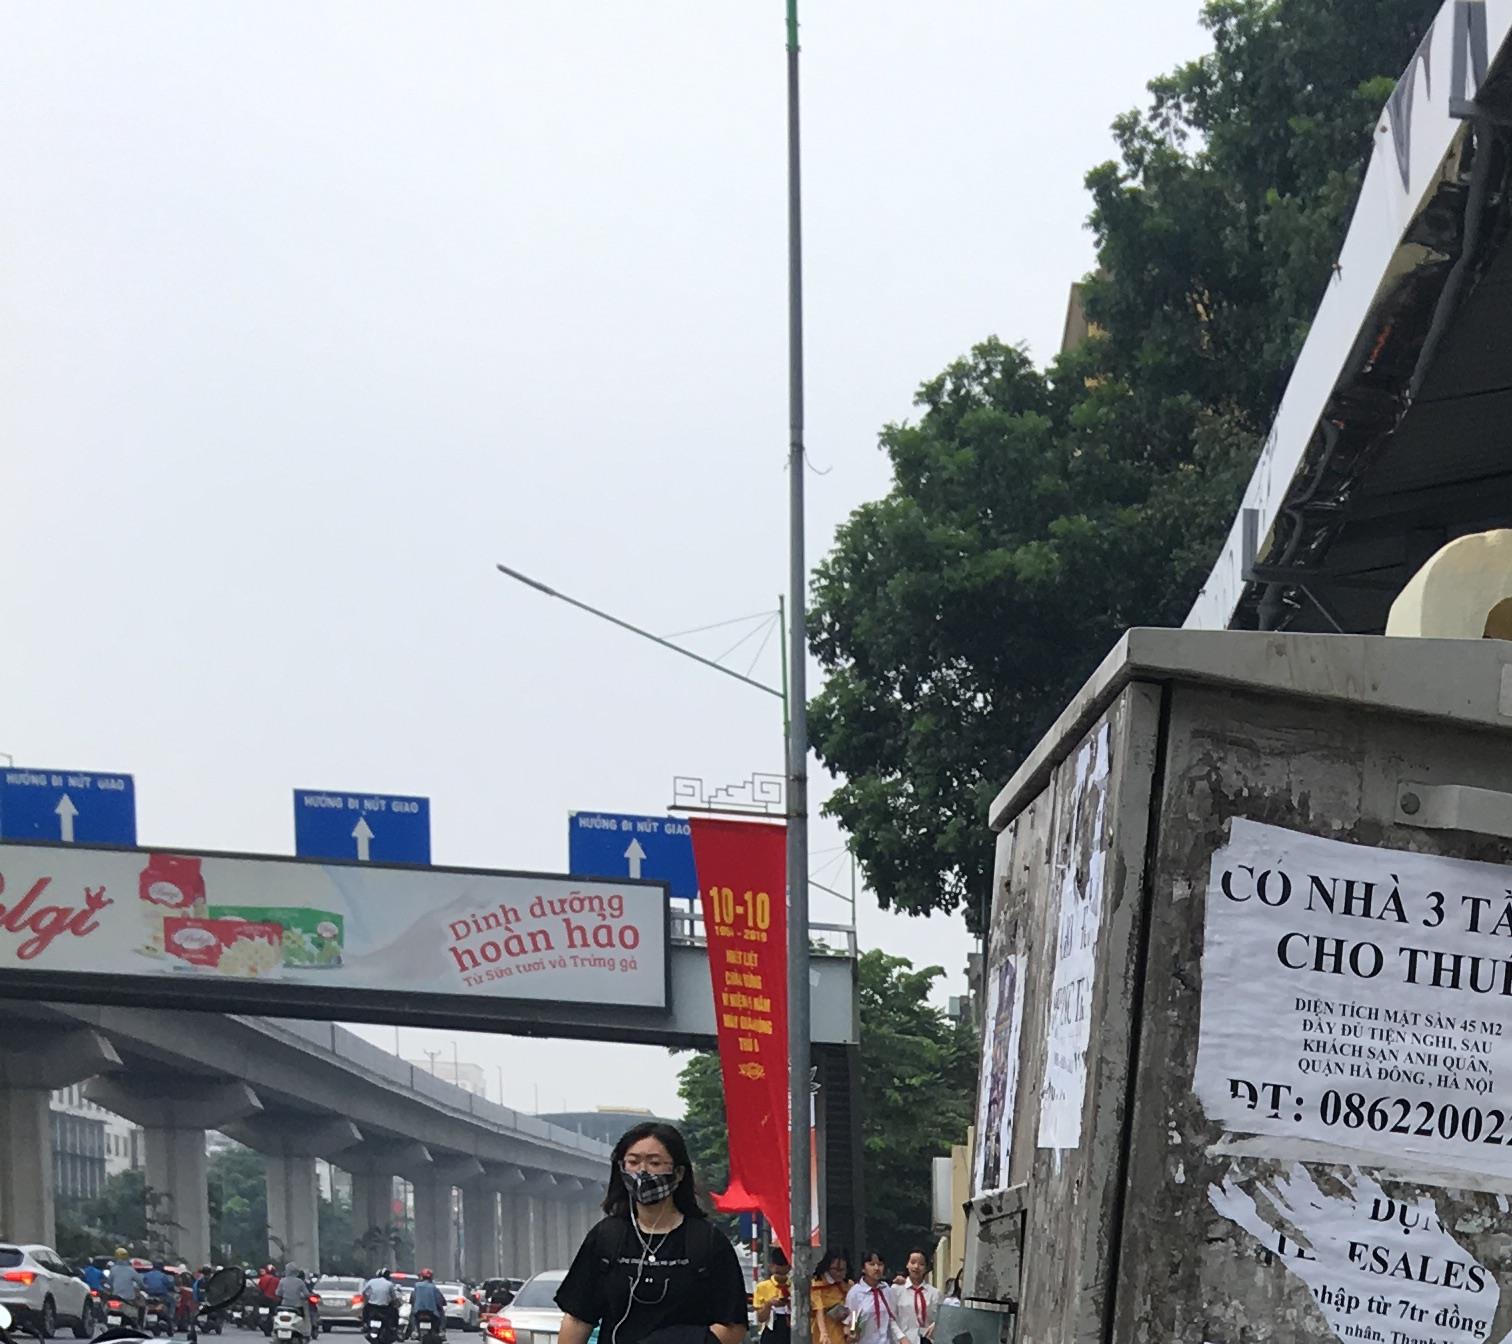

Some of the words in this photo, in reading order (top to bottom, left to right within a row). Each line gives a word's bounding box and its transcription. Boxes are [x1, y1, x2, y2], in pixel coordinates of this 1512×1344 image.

[664, 823, 692, 835] GIAO
[709, 886, 770, 930] 10-10
[1221, 857, 1292, 906] CÓ
[1303, 873, 1409, 924] NHÀ
[1422, 891, 1445, 928] 3
[448, 904, 521, 941] Dinh
[529, 891, 624, 919] dưỡng
[449, 925, 554, 972] hoàn
[562, 913, 640, 950] hảo
[1277, 932, 1384, 979] CHO
[1295, 997, 1335, 1016] DIỆN
[1339, 1001, 1379, 1021] TÍCH
[1383, 1009, 1421, 1029] MẶT
[1424, 1012, 1457, 1030] SÀN
[1460, 1019, 1477, 1033] 45
[1479, 1021, 1503, 1036] M2
[1341, 1021, 1364, 1038] ĐỦ
[1368, 1027, 1407, 1045] TIỆN
[1461, 1039, 1493, 1054] SAU
[1298, 1057, 1345, 1077] QUẬN
[1349, 1061, 1373, 1079] HÀ
[1377, 1066, 1425, 1085] ĐÔNG
[1437, 1072, 1460, 1089] HÀ
[1464, 1076, 1494, 1095] NỘI
[1302, 1038, 1363, 1058] KHÁCH
[1367, 1046, 1399, 1064] SẠN
[1402, 1051, 1438, 1067] ANH
[1442, 1055, 1494, 1075] QUÂN,
[1367, 1295, 1392, 1316] từ
[1398, 1299, 1430, 1323] 7tr
[1434, 1304, 1488, 1339] đồng
